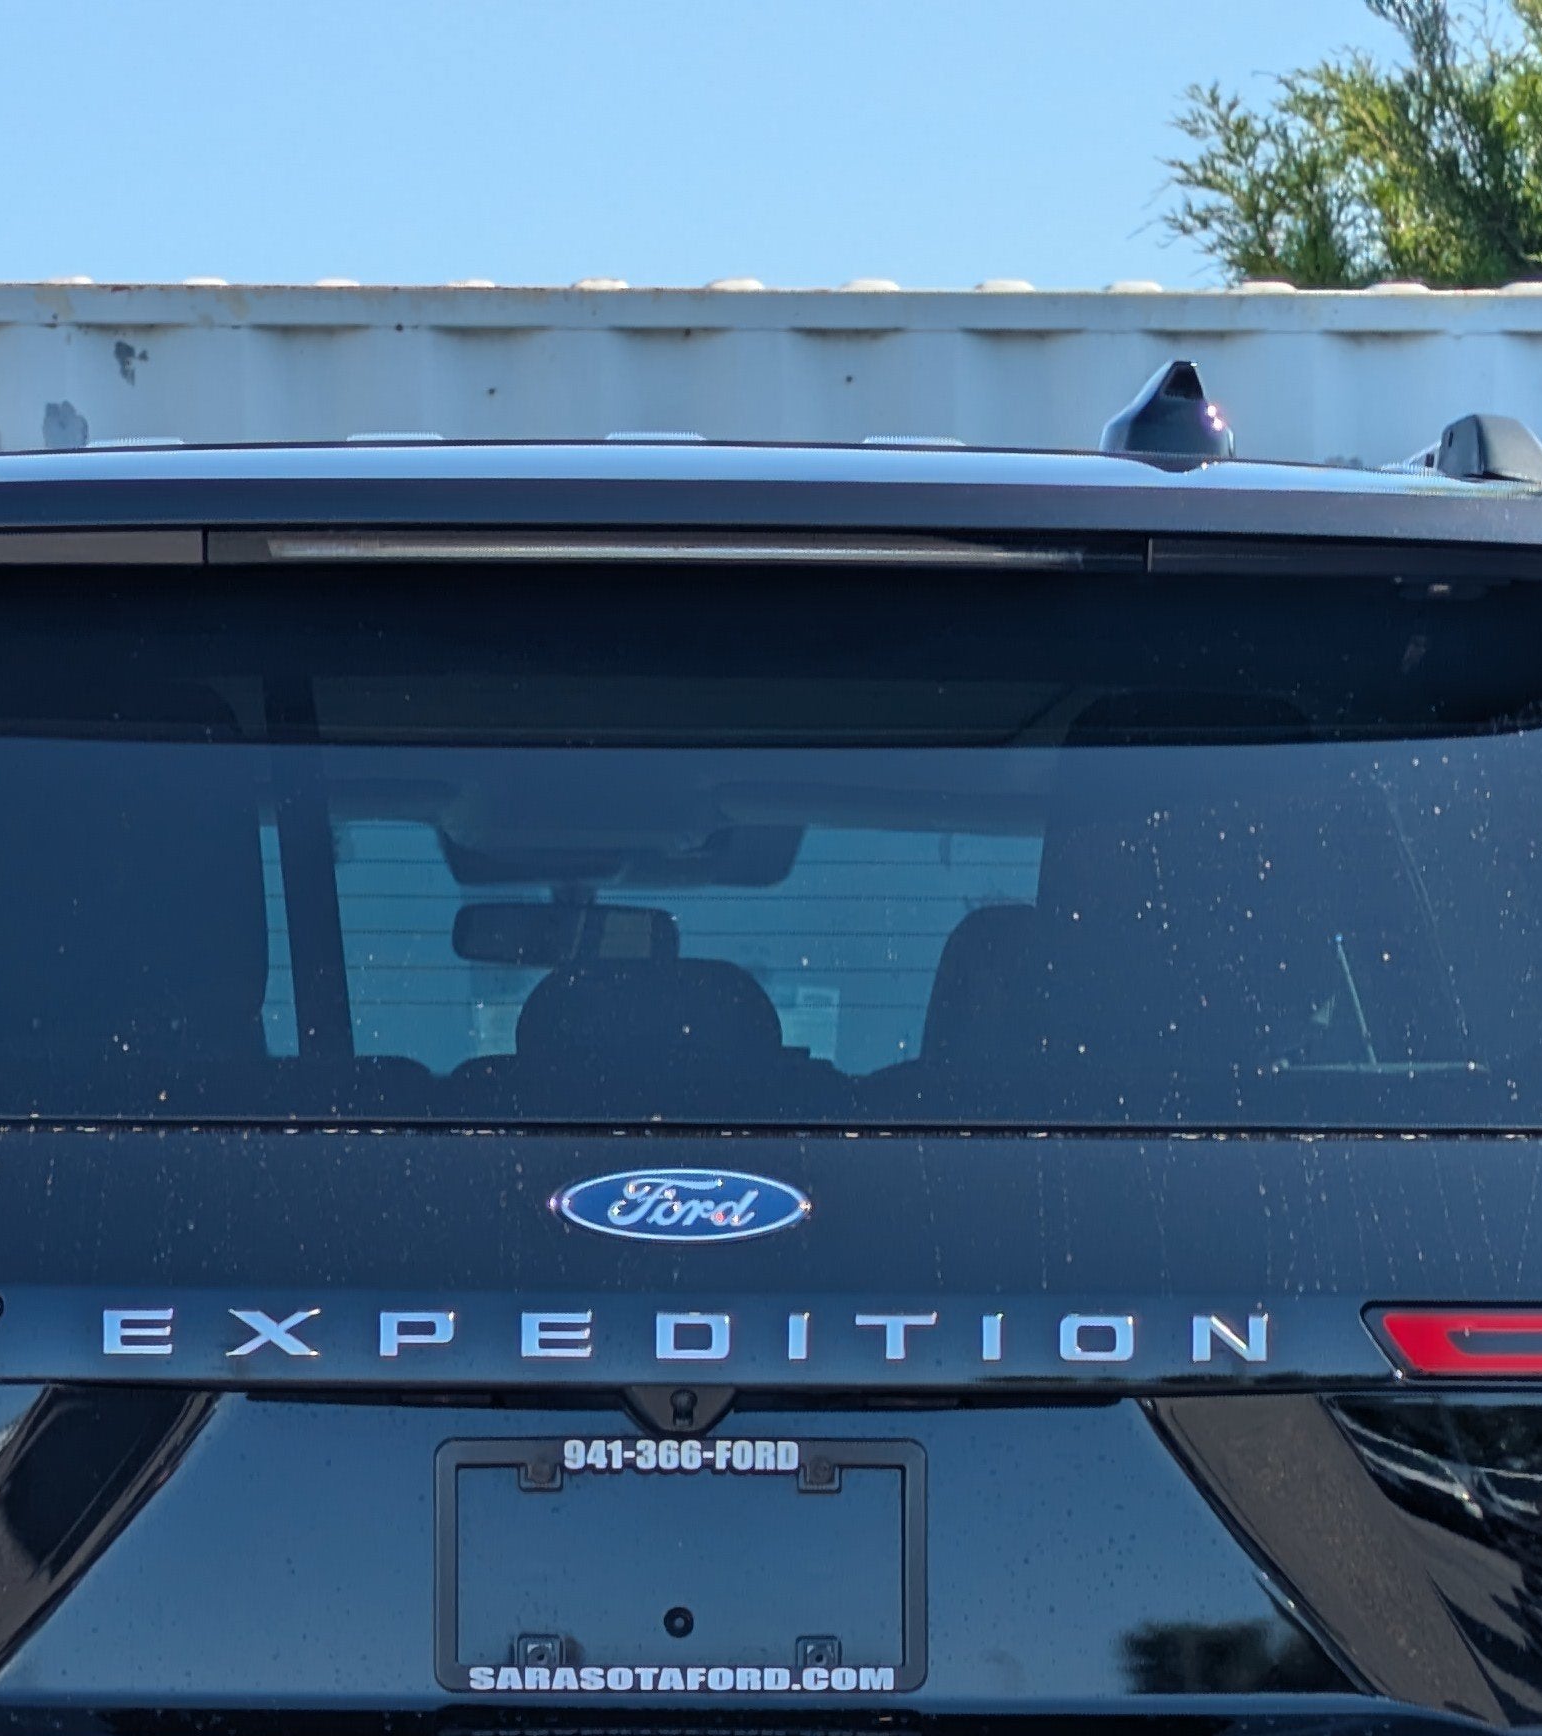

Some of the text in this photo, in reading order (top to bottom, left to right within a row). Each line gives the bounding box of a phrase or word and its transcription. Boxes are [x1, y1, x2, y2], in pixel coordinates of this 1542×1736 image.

[606, 1178, 757, 1227] Ford
[102, 1307, 1270, 1363] EXPEDITION
[563, 1439, 799, 1472] 941-366-FORD
[469, 1666, 894, 1691] SARASOTAFORD.COM
